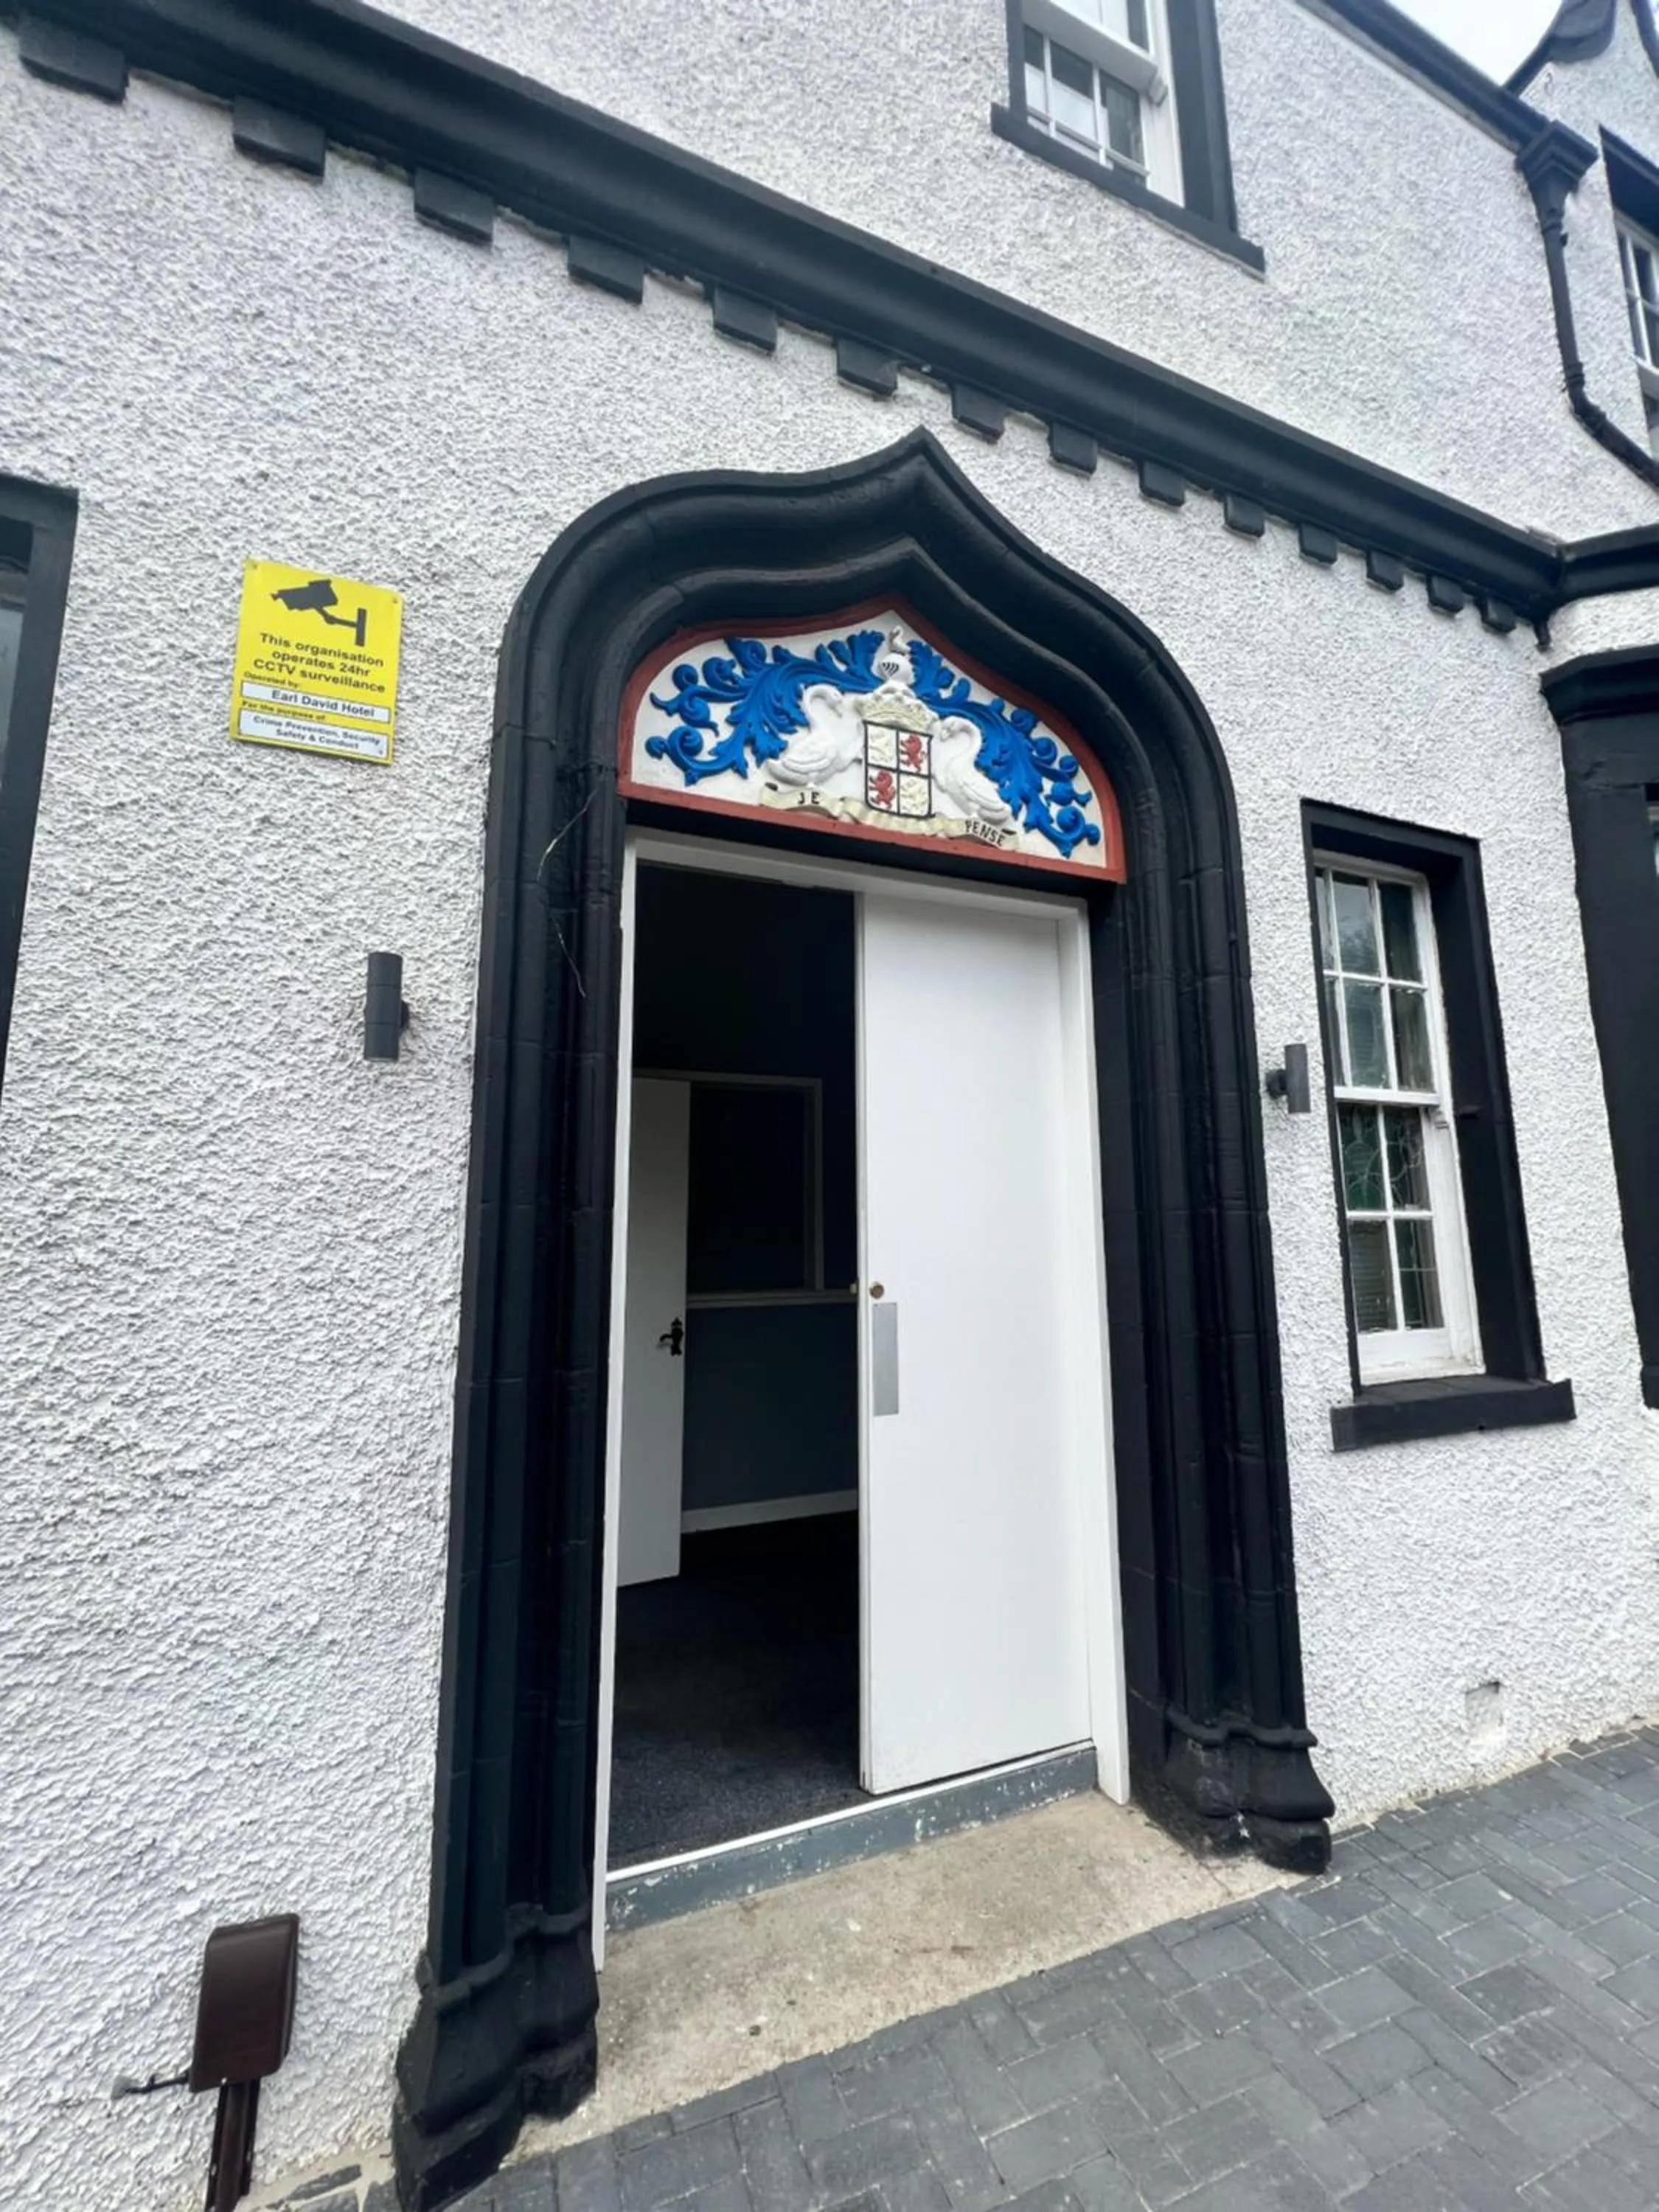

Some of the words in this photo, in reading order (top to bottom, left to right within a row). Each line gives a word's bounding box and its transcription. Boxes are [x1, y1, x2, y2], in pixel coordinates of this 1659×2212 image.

[260, 632, 291, 647] This
[295, 642, 384, 667] organisation
[272, 651, 335, 669] operates
[339, 663, 370, 676] 24hr
[253, 658, 296, 675] CCTV
[299, 669, 385, 693] surveillance
[271, 689, 298, 703] Earl
[302, 695, 338, 709] David
[342, 703, 375, 717] Hotel
[253, 715, 282, 726] Crime
[342, 731, 381, 745] Security
[276, 728, 305, 740] Safety
[964, 819, 1006, 846] PENSE
